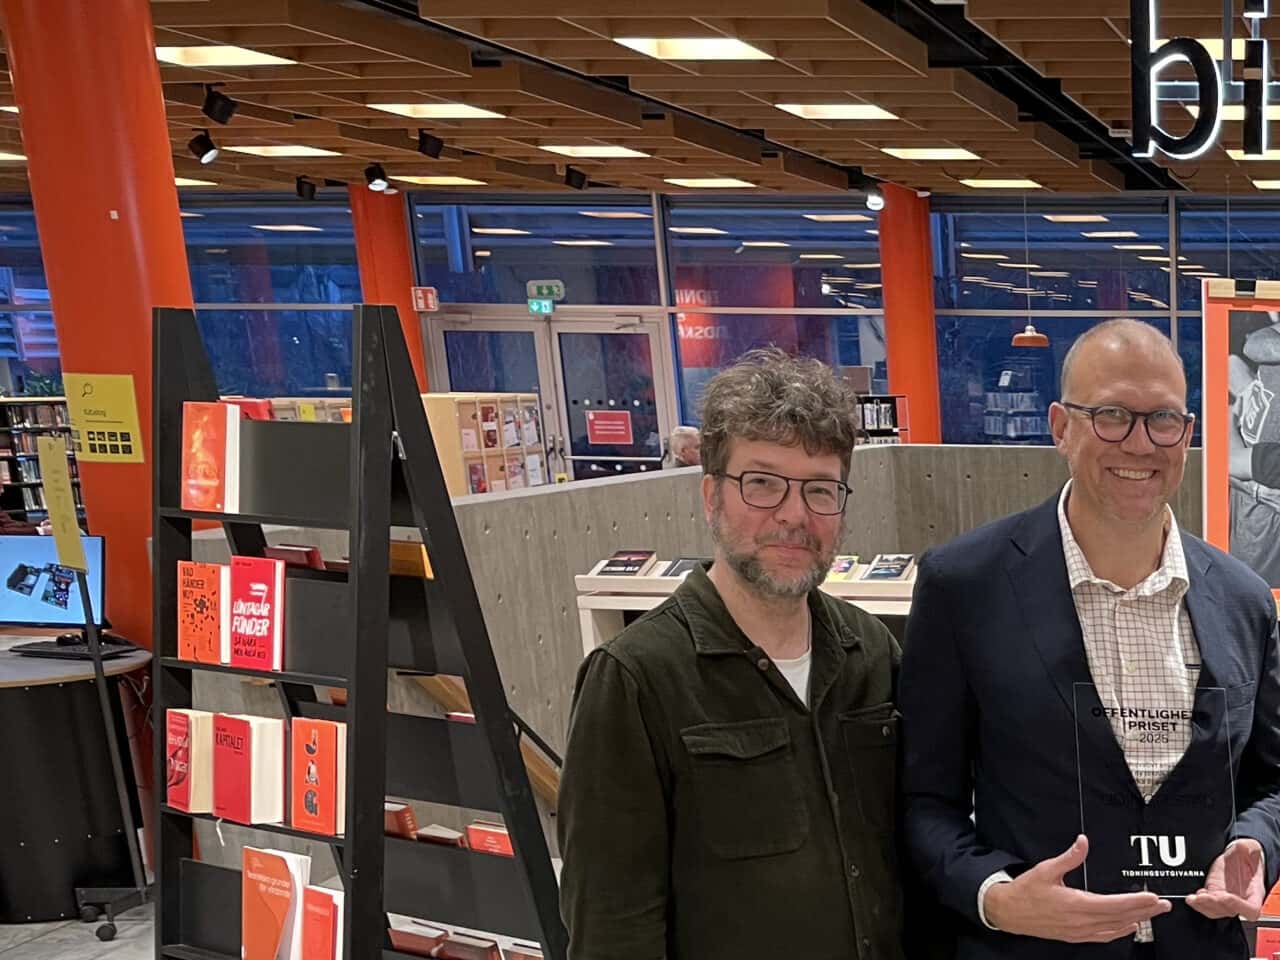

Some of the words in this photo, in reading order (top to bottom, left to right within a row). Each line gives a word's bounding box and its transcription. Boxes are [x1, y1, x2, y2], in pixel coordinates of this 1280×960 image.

[1128, 721, 1178, 732] PRISET
[1130, 835, 1187, 867] TU
[1121, 870, 1205, 878] TIDNINGSUTGIVARNA
